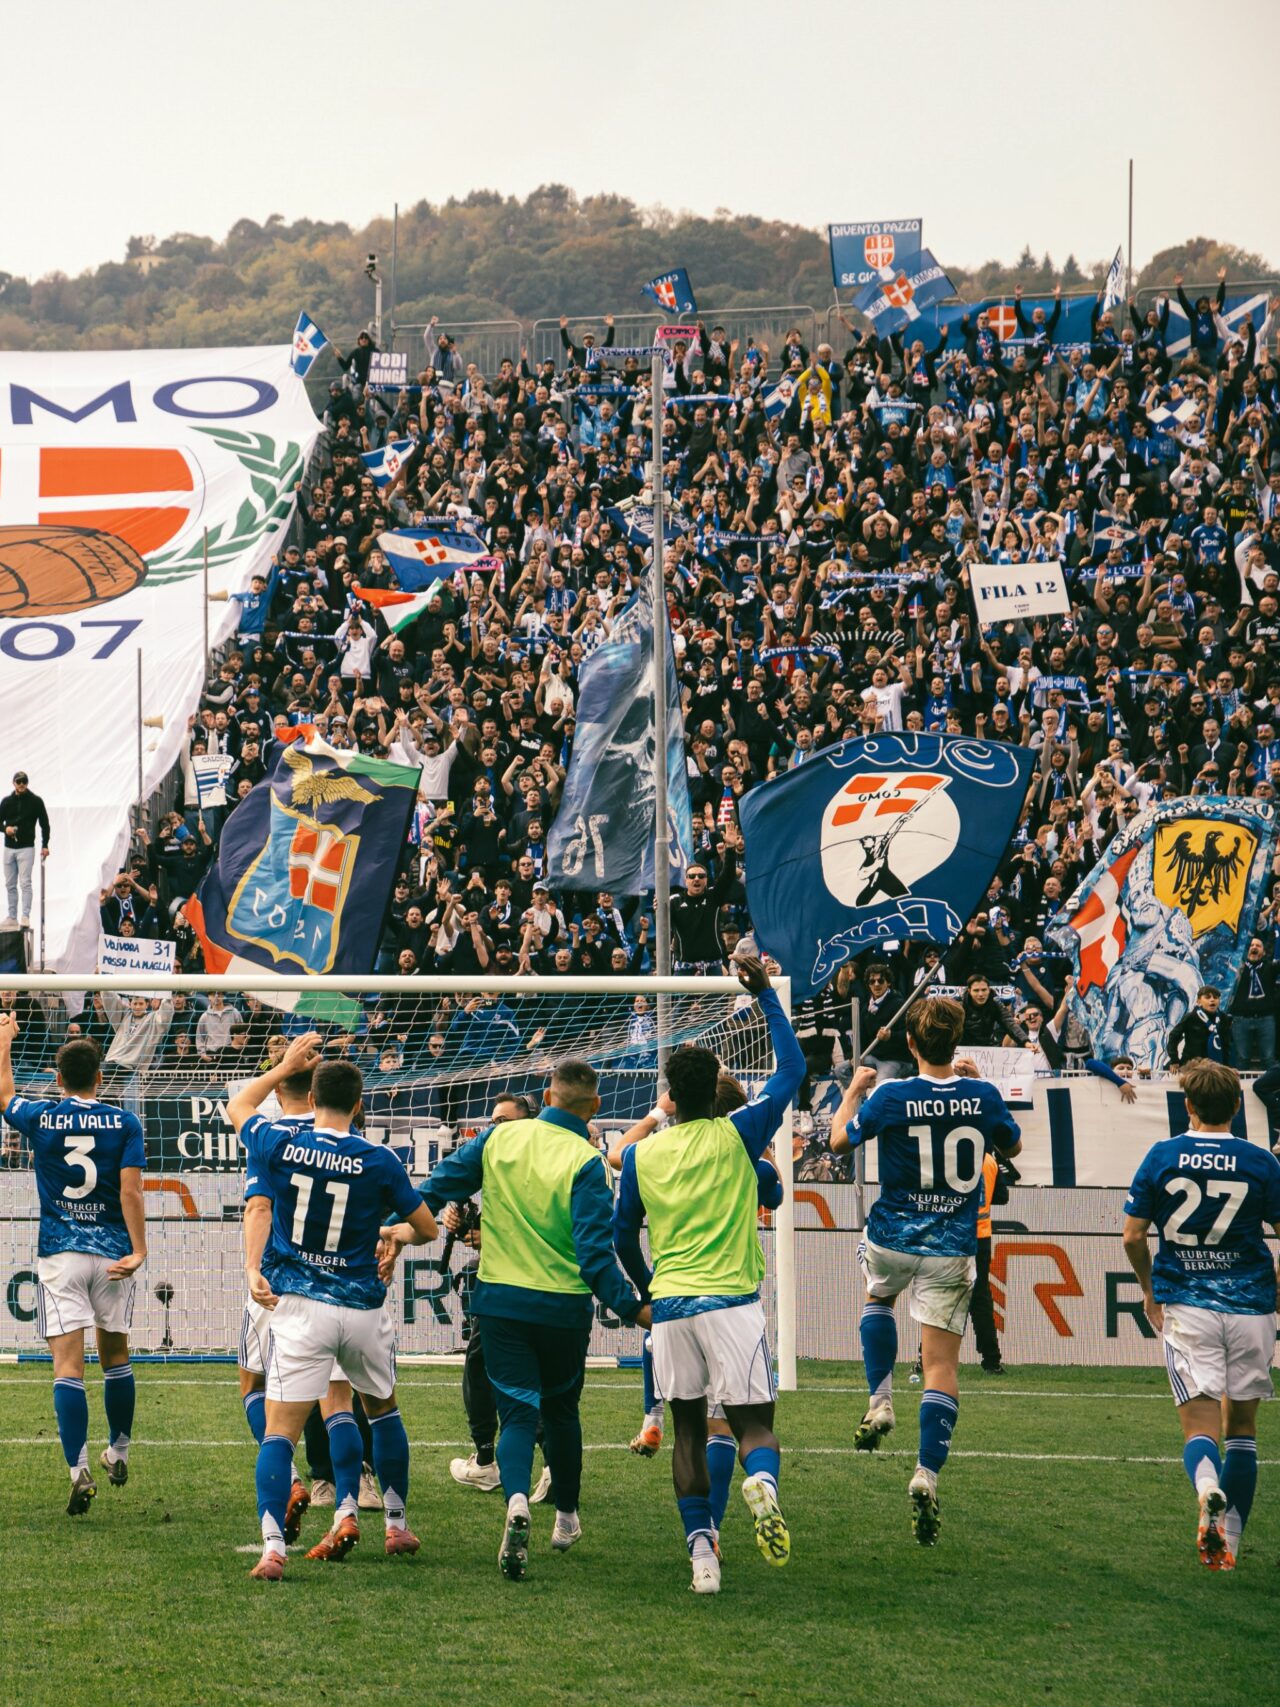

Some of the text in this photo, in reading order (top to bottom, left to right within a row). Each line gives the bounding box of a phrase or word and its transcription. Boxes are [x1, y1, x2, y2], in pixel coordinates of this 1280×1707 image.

[832, 221, 920, 236] DIVENTO PAZZO
[841, 272, 855, 284] SE
[663, 327, 696, 335] COMO
[371, 353, 407, 367] PODI
[369, 368, 407, 384] MINGA
[981, 581, 1058, 600] FILA 12
[153, 941, 170, 957] 31
[103, 955, 127, 967] POSSO
[142, 961, 172, 972] MAGLIA
[1001, 1050, 1022, 1065] 27
[906, 1098, 982, 1118] NICO PAZ
[40, 1111, 122, 1129] ÁLEX VALLE
[282, 1143, 363, 1175] DOUVIKAS
[908, 1125, 985, 1194] 10
[1178, 1153, 1237, 1172] POSCH
[62, 1136, 98, 1199] 3
[53, 1200, 106, 1211] EUBERGER
[908, 1193, 968, 1205] NEUBERG
[290, 1173, 349, 1252] 11
[917, 1203, 955, 1214] BERMA
[1163, 1177, 1249, 1247] 27
[298, 1251, 348, 1267] BERGER
[1174, 1250, 1241, 1261] NEUBERGER
[1184, 1261, 1232, 1271] BERMAN
